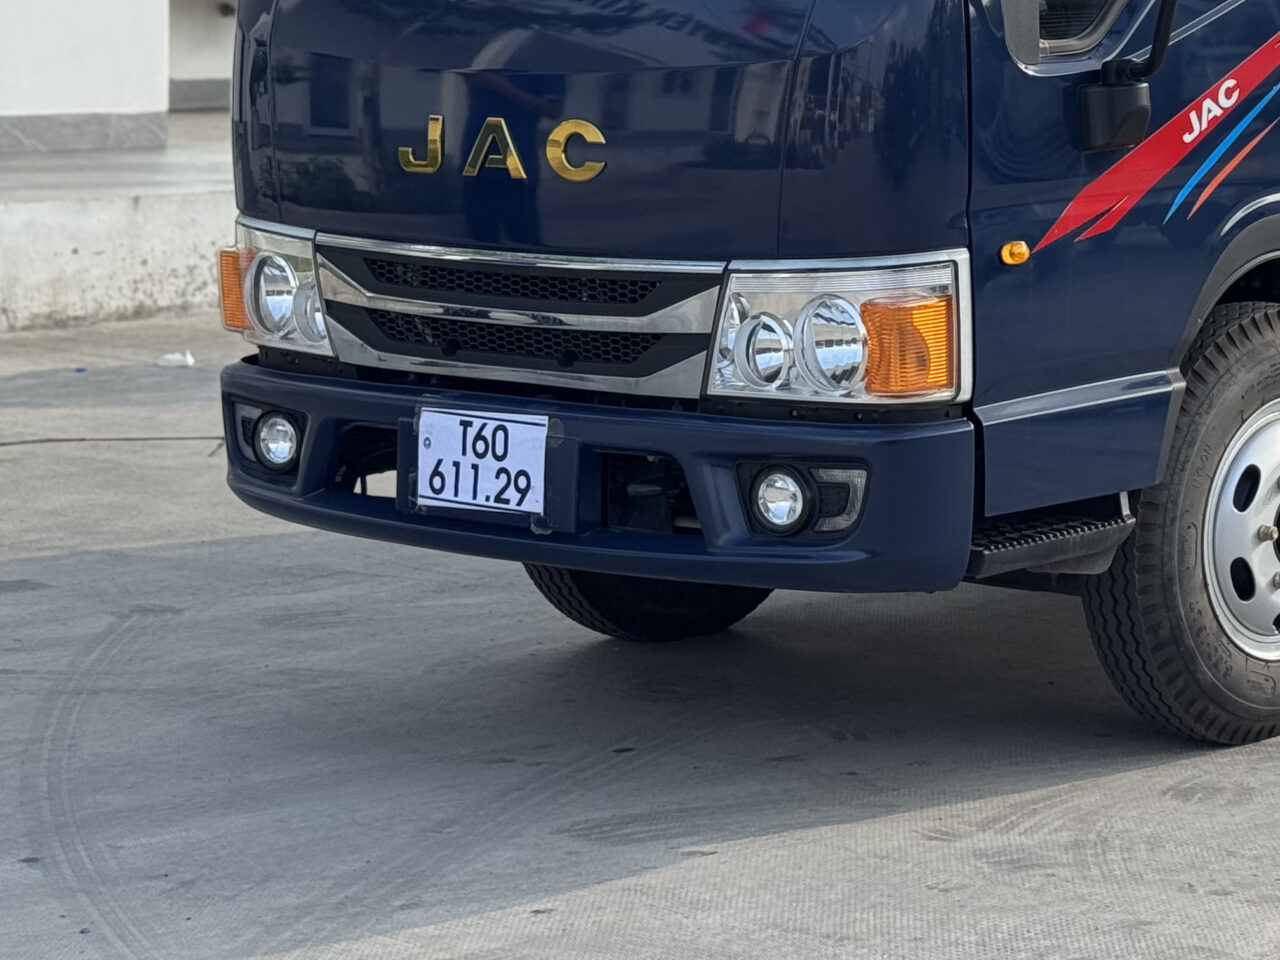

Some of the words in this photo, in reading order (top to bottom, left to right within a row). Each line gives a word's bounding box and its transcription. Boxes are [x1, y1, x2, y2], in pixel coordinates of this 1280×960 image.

[1182, 78, 1240, 145] JAC
[399, 115, 607, 182] JAC
[459, 419, 509, 462] T60
[429, 458, 532, 507] 611.29
